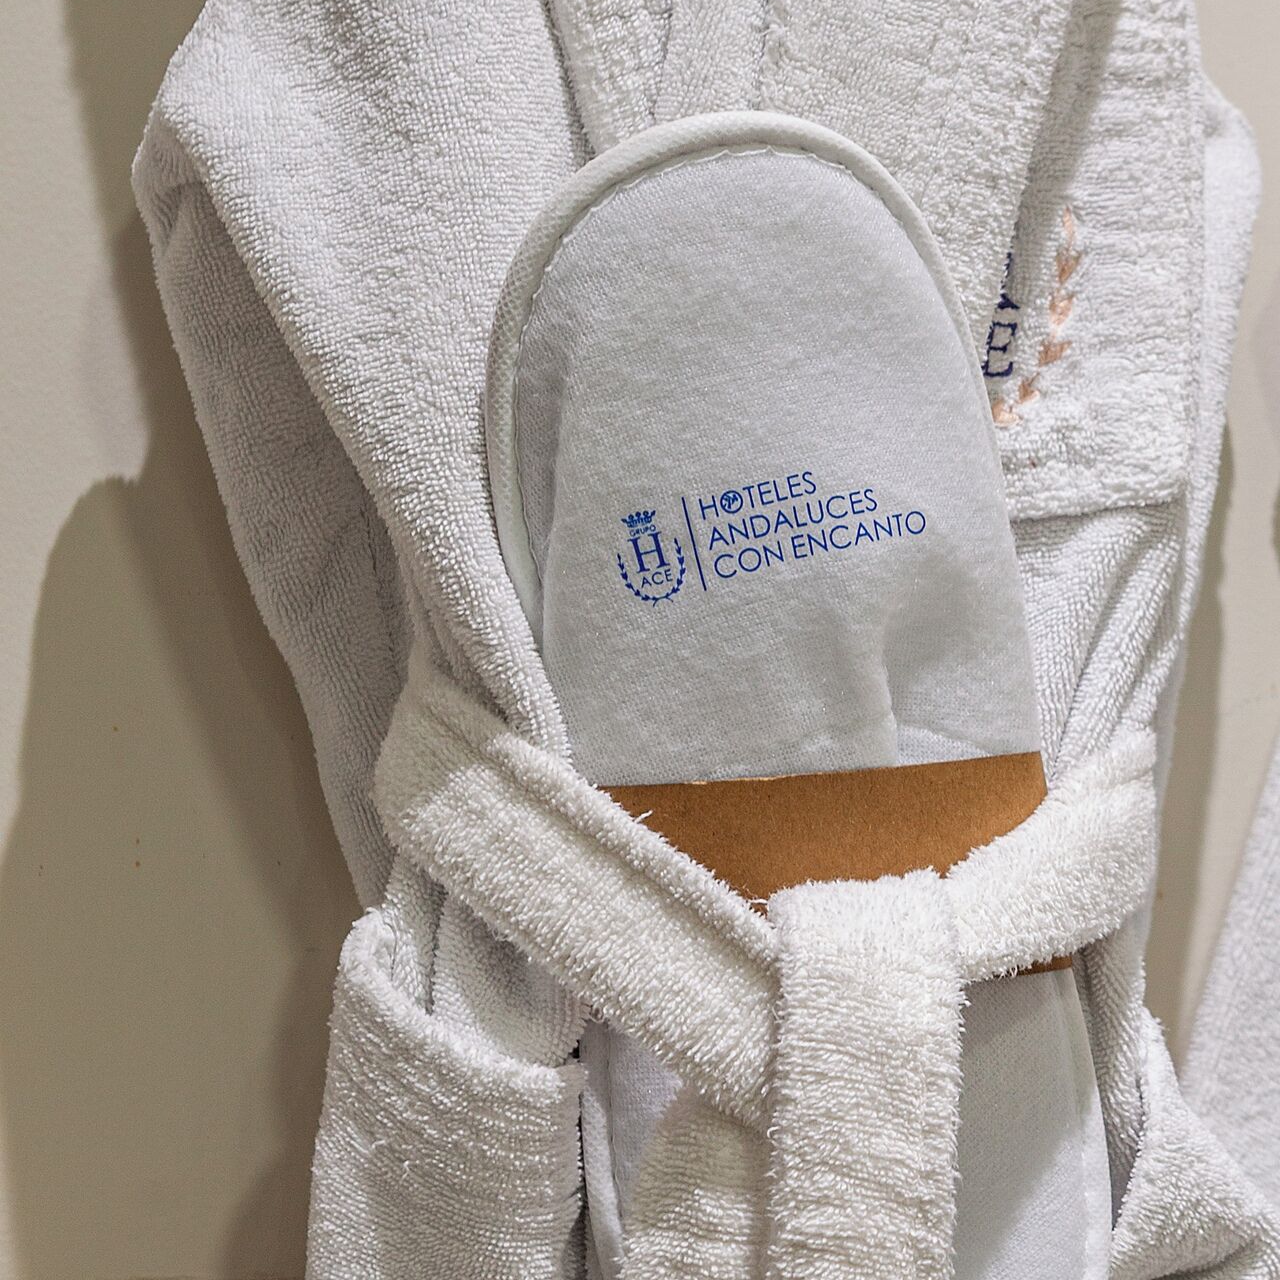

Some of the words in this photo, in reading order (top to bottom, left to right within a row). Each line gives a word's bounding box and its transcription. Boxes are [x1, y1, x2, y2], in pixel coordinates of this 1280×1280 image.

[698, 471, 817, 520] HOTELES
[708, 488, 878, 550] ANDALUCES
[713, 540, 784, 578] CON
[791, 511, 927, 559] ENCANTO
[641, 568, 673, 588] ACE
